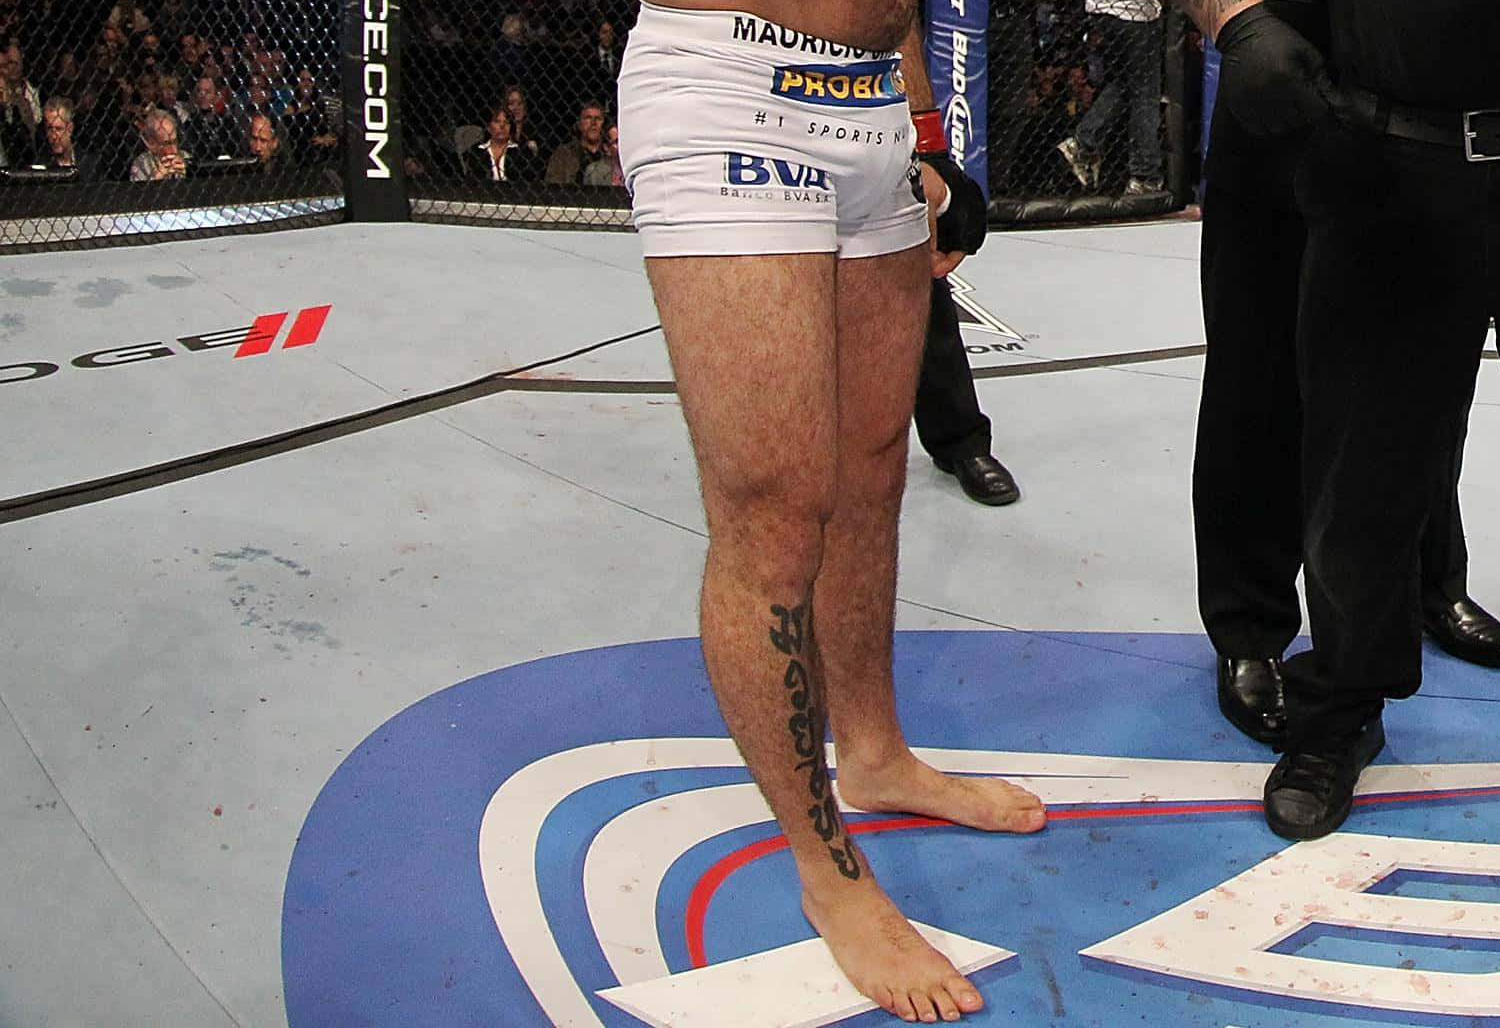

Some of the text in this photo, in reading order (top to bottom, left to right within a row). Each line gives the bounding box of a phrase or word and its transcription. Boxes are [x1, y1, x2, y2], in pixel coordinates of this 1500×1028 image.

[953, 31, 969, 94] BUD
[807, 122, 883, 145] SPORTS
[785, 191, 811, 203] BVA
